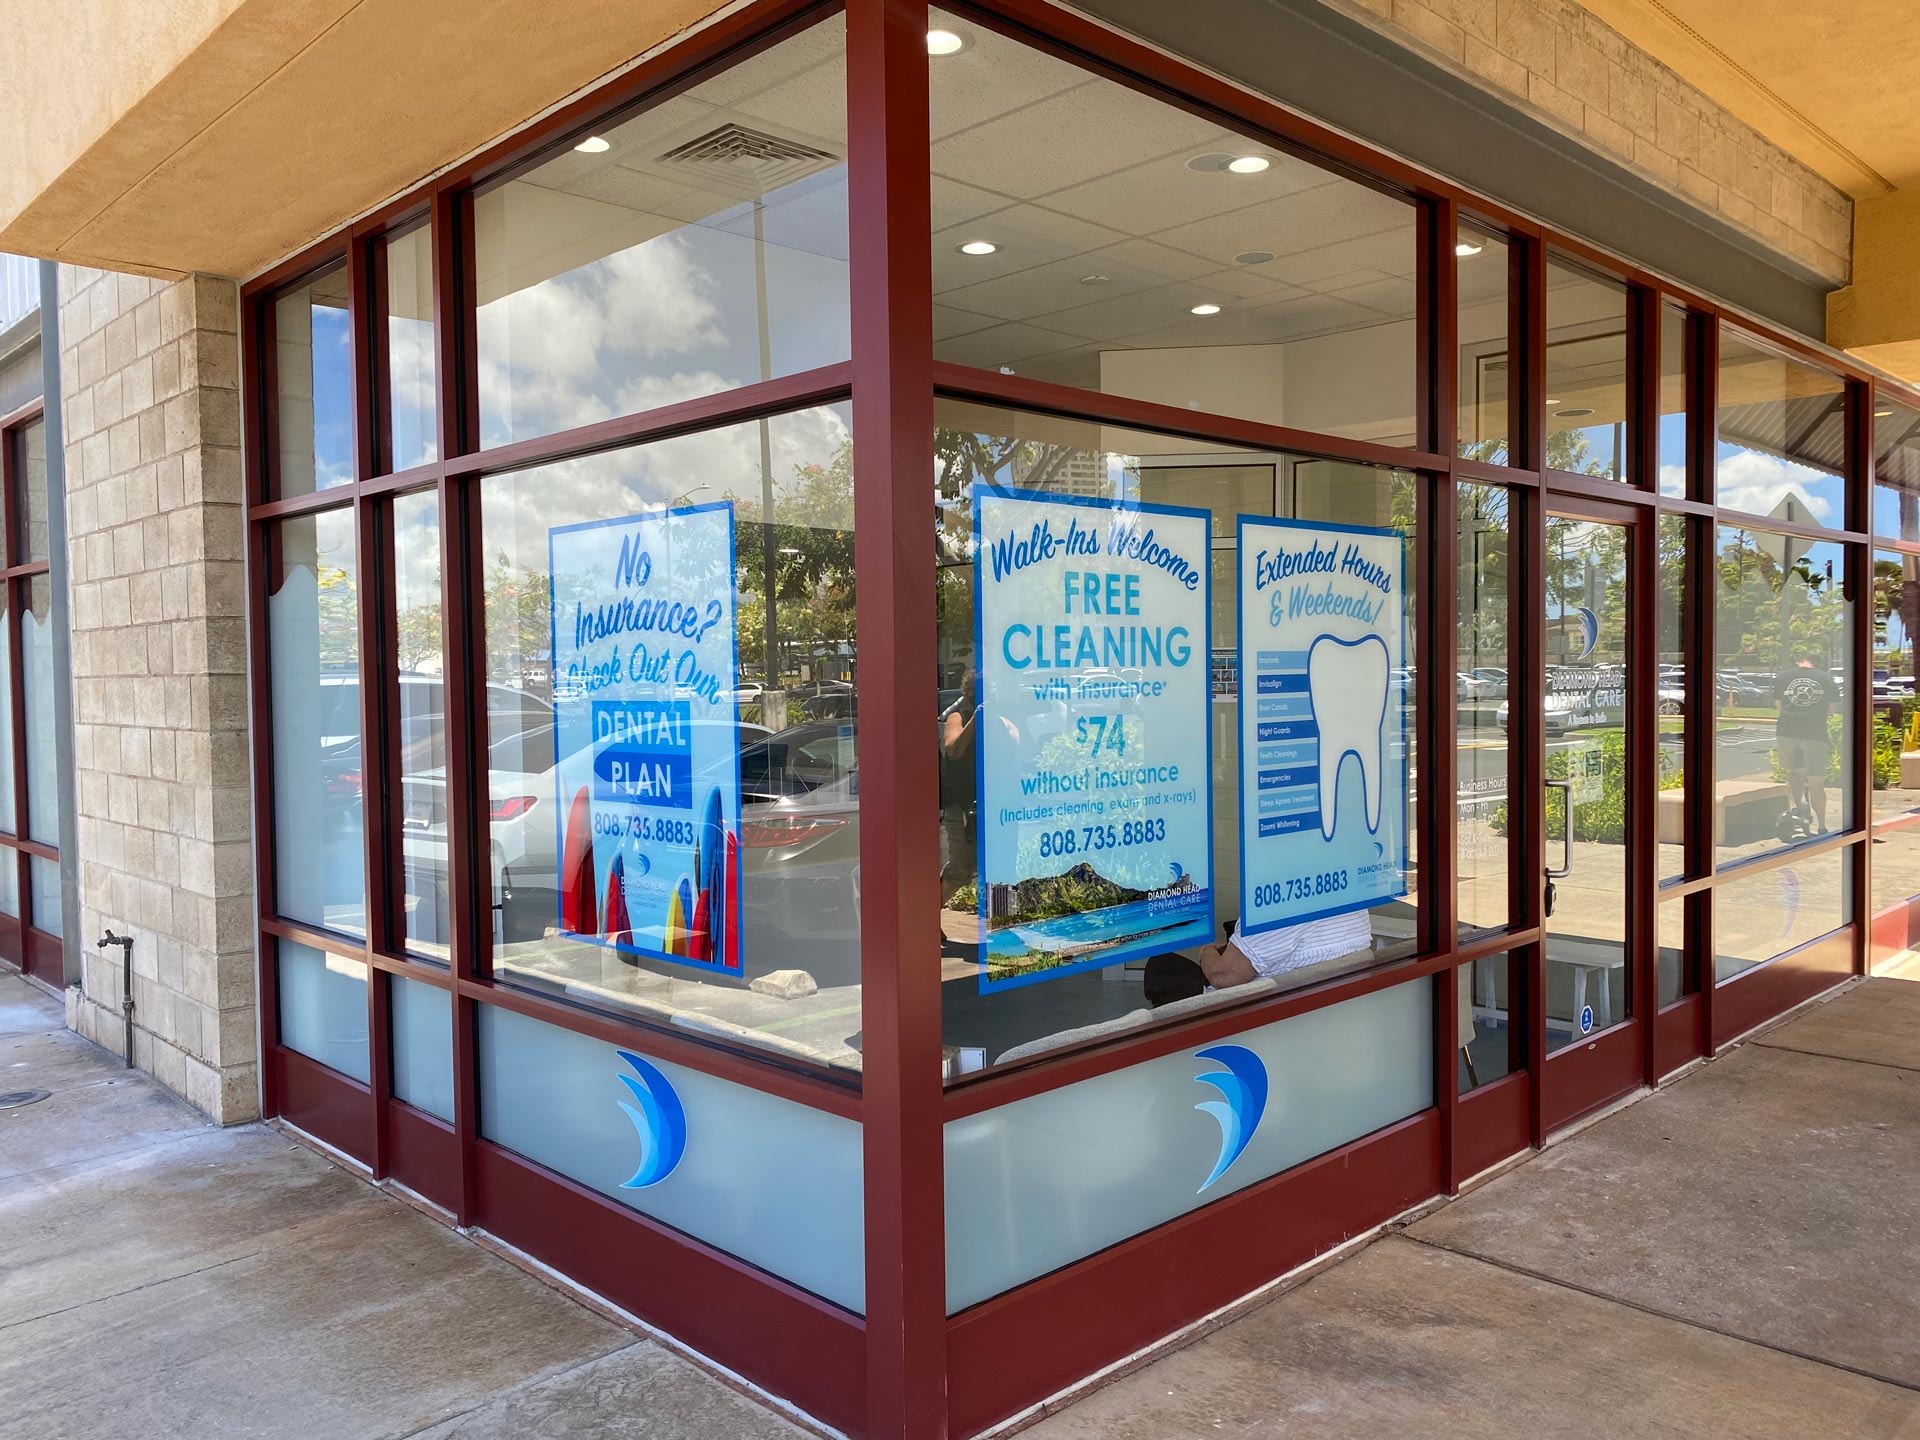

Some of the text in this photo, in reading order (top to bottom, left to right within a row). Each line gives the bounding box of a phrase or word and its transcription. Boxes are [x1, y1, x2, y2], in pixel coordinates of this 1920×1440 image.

[615, 532, 651, 589] No
[992, 517, 1199, 591] Walk-Ins Welcome
[1256, 538, 1392, 594] Extended Hours
[1064, 571, 1140, 616] FREE
[1269, 581, 1385, 627] & Weekends!
[575, 596, 722, 650] Insurance?
[1002, 623, 1192, 669] CLEANING
[568, 643, 720, 705] Check Out Our
[1032, 678, 1071, 701] with
[1551, 670, 1621, 690] DIAMOND HEAD
[1552, 688, 1621, 710] DENTAL CARE
[597, 710, 686, 746] DENTAL
[1076, 714, 1126, 759] $74
[611, 761, 672, 798] PLAN
[1020, 764, 1179, 796] without insurance
[1260, 774, 1291, 784] Emergencies
[1460, 776, 1507, 792] Business Hours
[1000, 804, 1053, 826] (Includes
[1142, 791, 1160, 807] and
[1163, 788, 1196, 806] x-rays)
[1460, 802, 1475, 814] Mon
[1480, 800, 1489, 811] Fri
[594, 812, 694, 845] 808.735.8883
[1040, 817, 1166, 858] 808.735.8883
[1357, 863, 1383, 875] DIAMOND
[1148, 883, 1200, 901] DIAMOND HEAD
[1148, 898, 1177, 911] DENTAL
[1181, 893, 1200, 905] CARE
[1254, 869, 1348, 908] 808.735.8883
